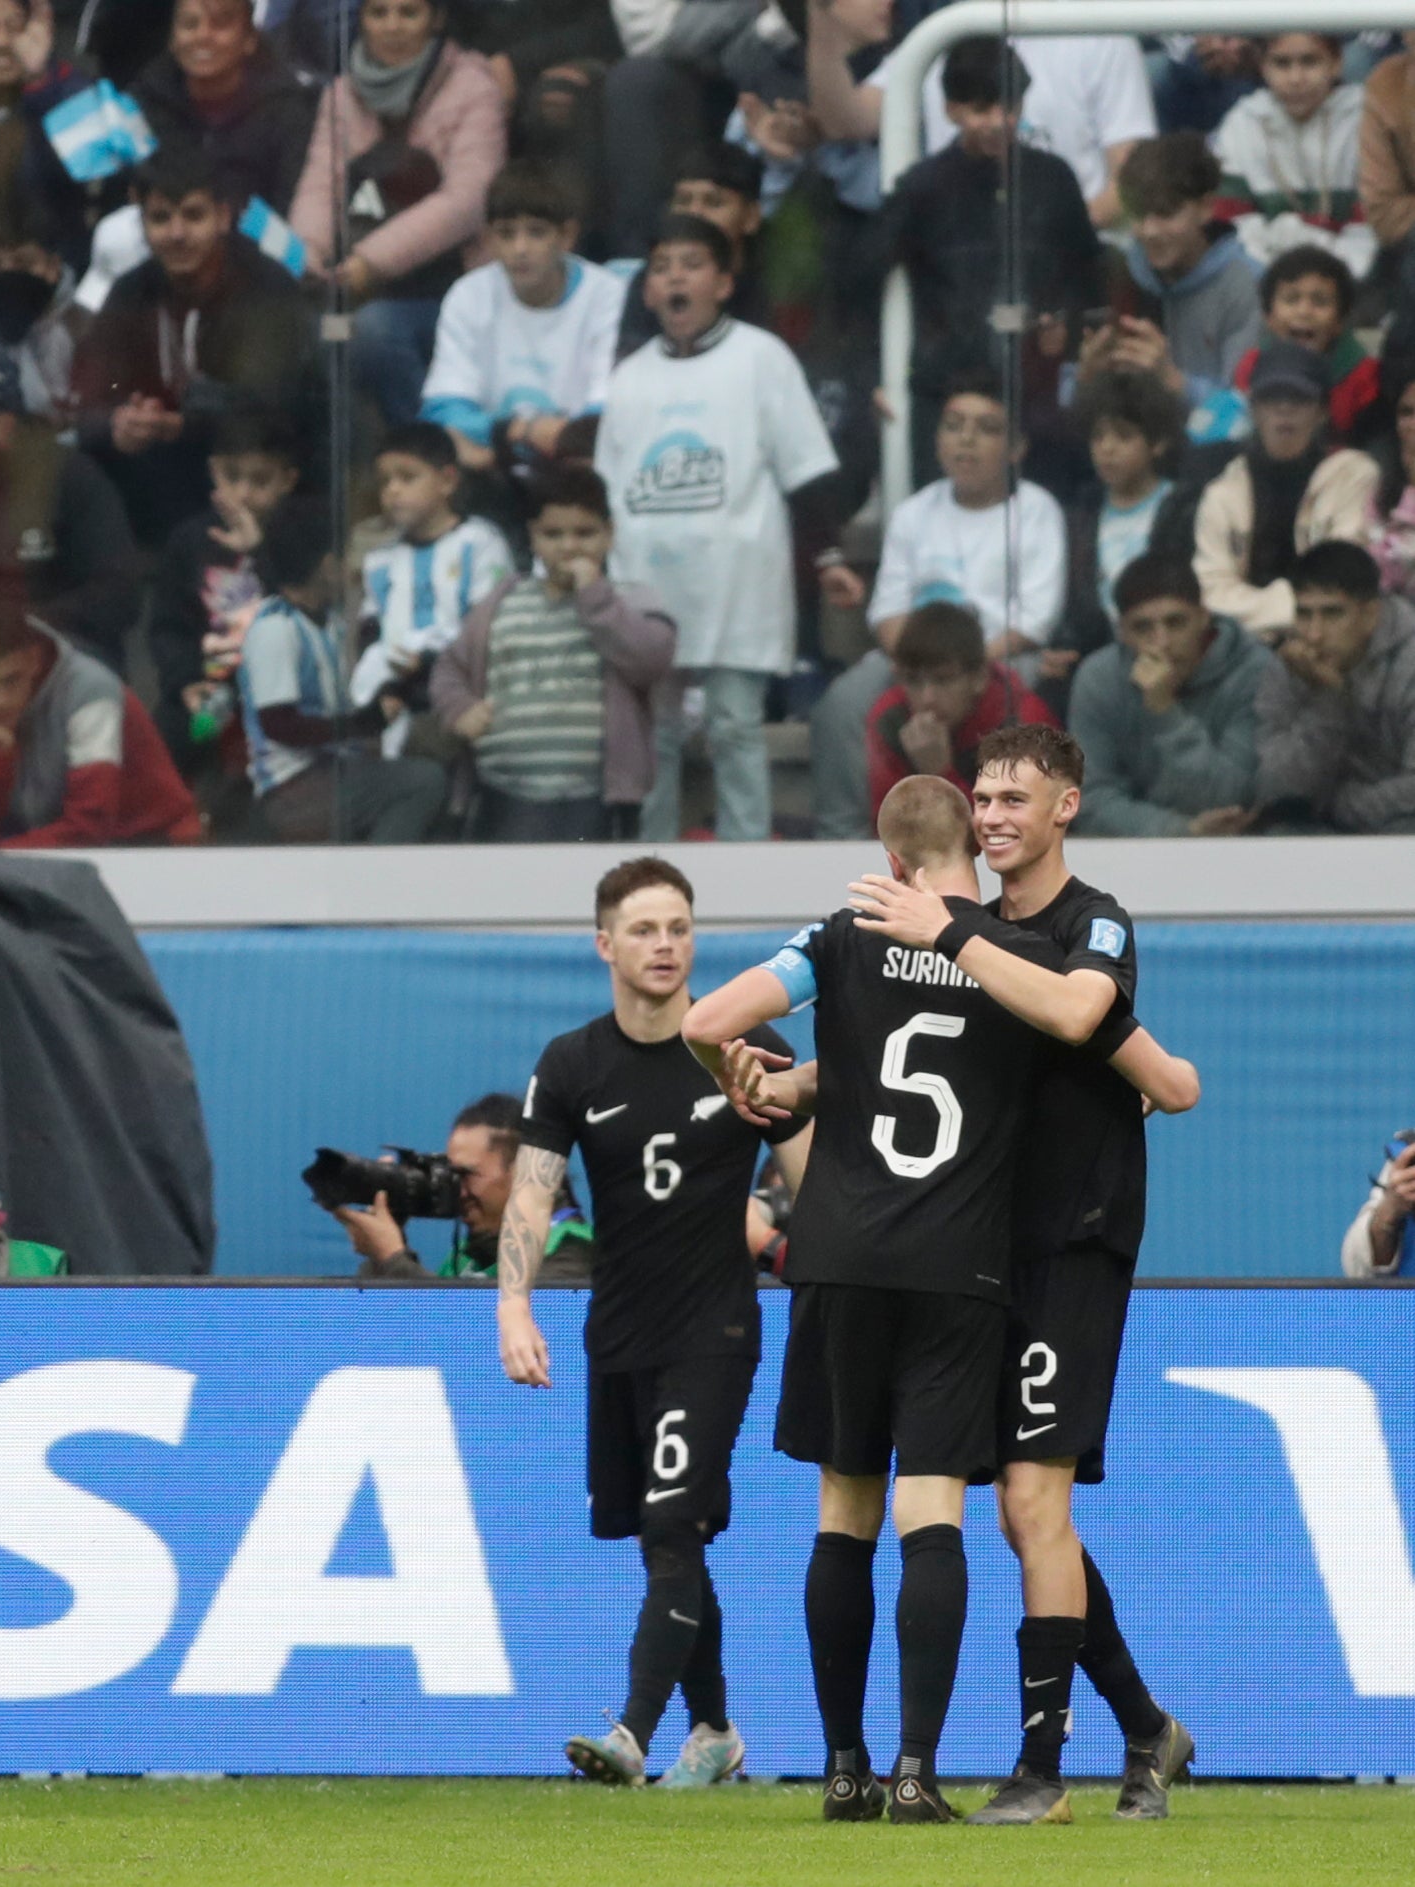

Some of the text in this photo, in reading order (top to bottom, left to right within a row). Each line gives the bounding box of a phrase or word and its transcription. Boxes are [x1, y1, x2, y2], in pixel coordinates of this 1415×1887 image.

[871, 1012, 966, 1179] 5
[643, 1133, 682, 1200] 6
[1020, 1341, 1058, 1415] 2
[653, 1409, 689, 1480] 6
